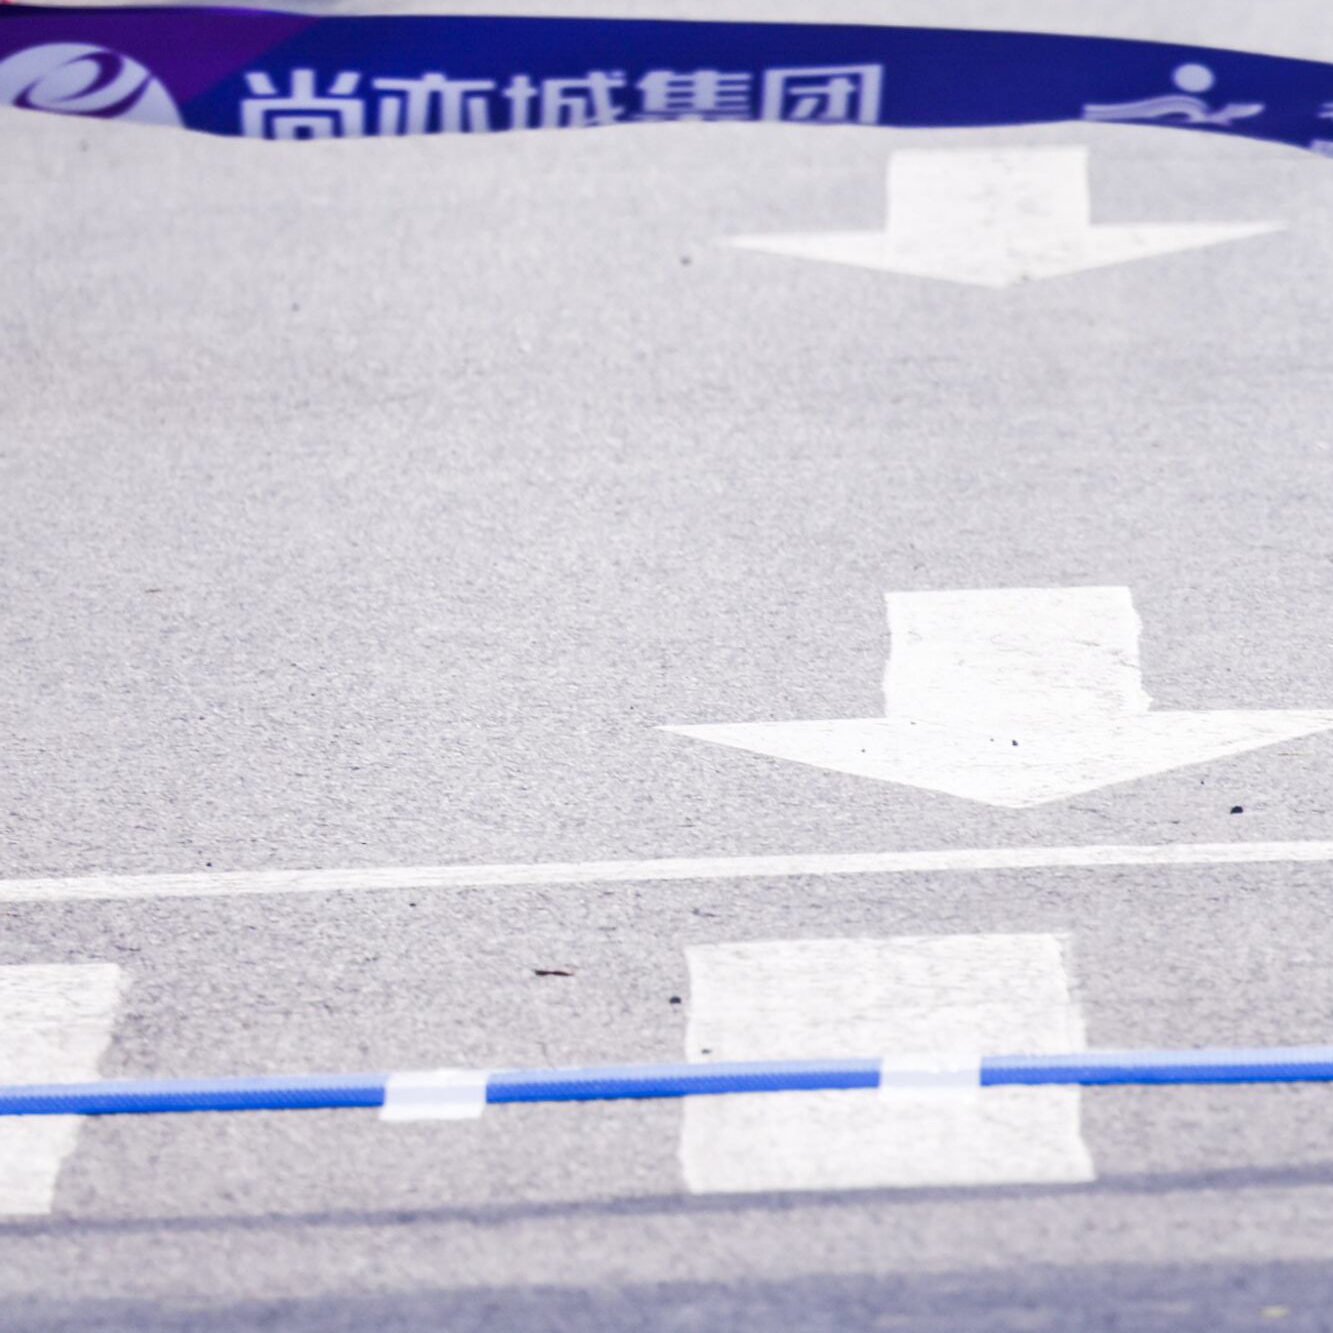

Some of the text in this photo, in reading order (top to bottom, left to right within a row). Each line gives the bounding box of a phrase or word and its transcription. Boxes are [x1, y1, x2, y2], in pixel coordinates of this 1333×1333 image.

[240, 65, 882, 141] 尚亦城集团
